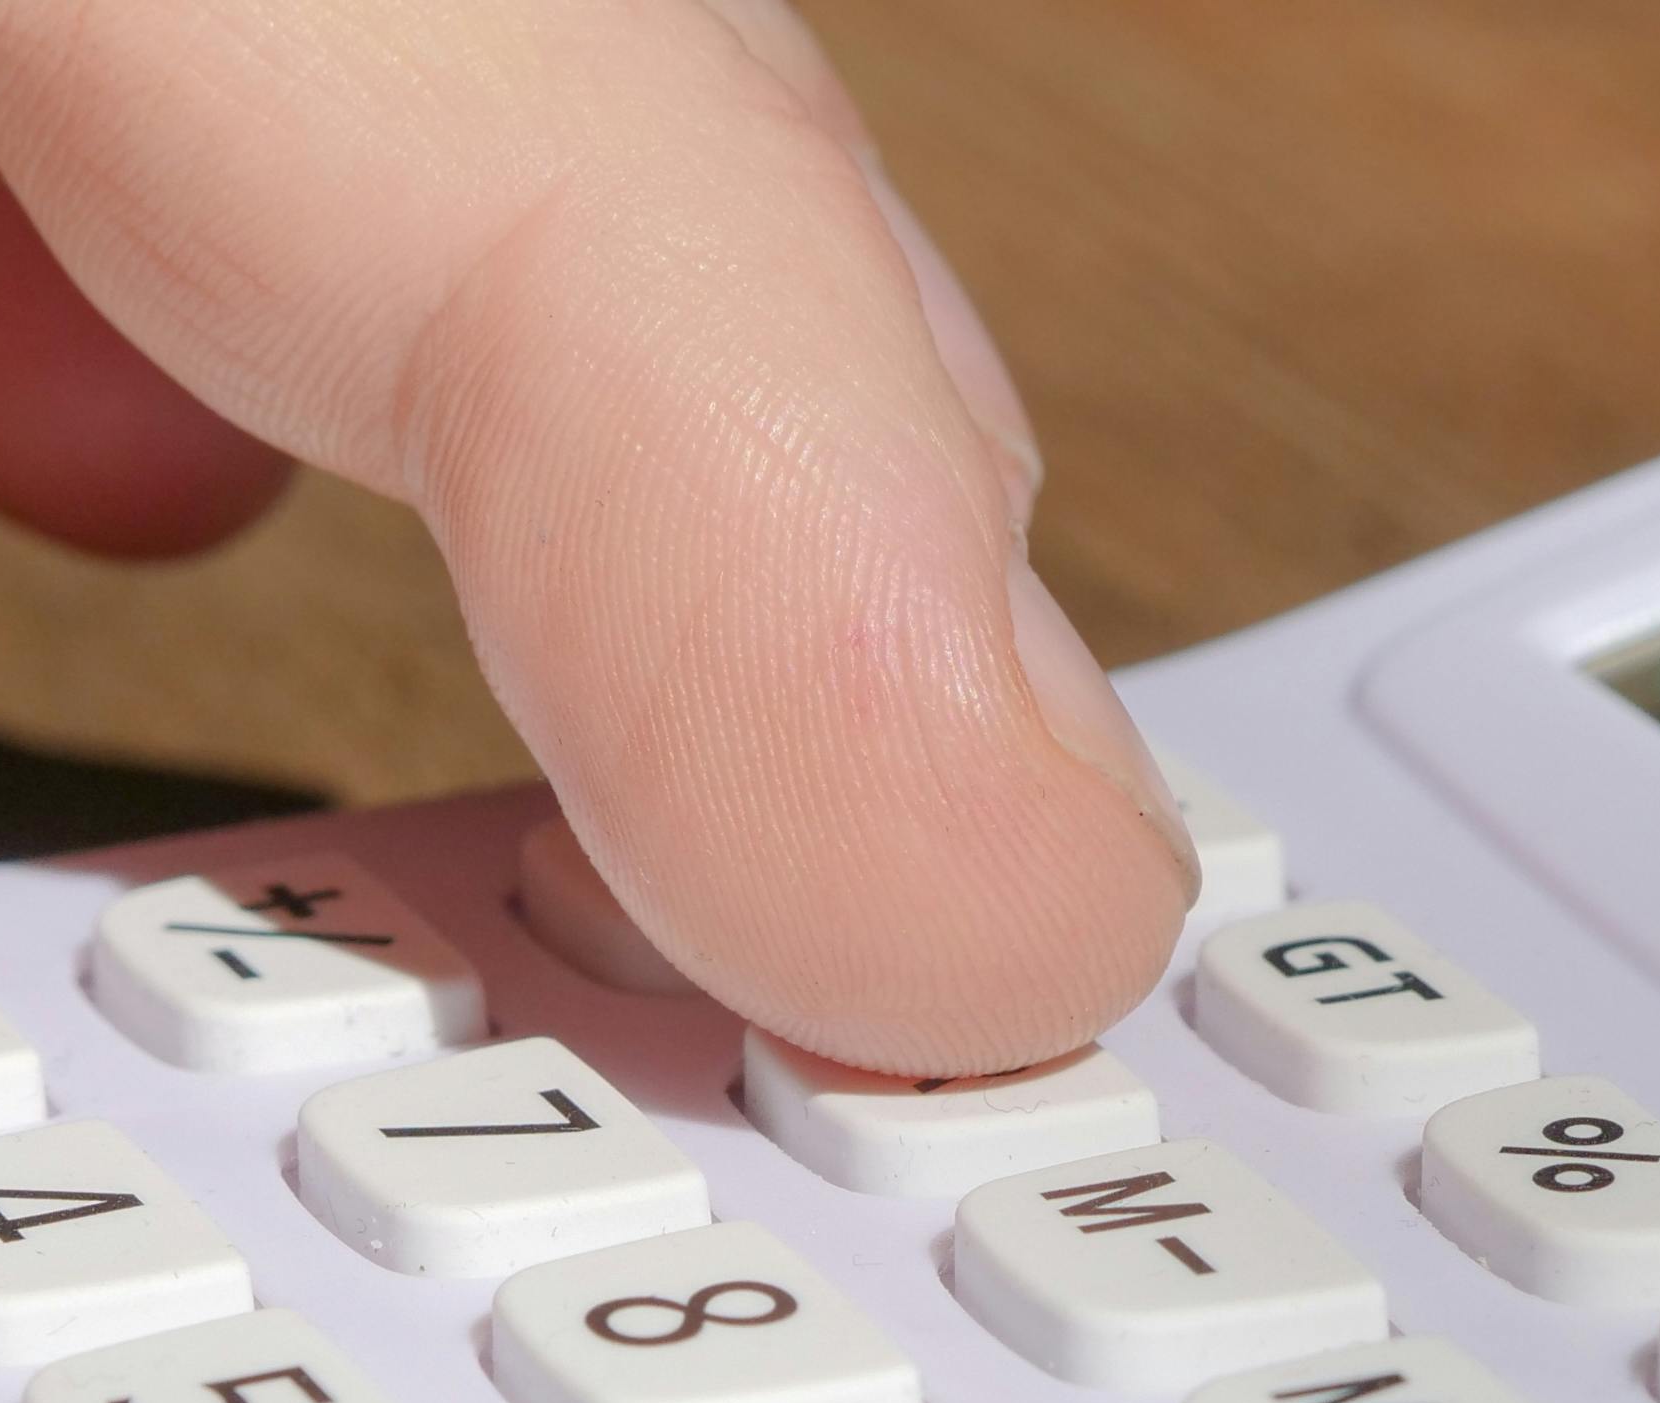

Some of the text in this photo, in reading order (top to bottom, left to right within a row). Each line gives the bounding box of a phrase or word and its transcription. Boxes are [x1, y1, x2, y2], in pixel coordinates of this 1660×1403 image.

[1262, 936, 1444, 1005] GT
[378, 1088, 602, 1138] 7
[584, 1280, 799, 1347] 8
